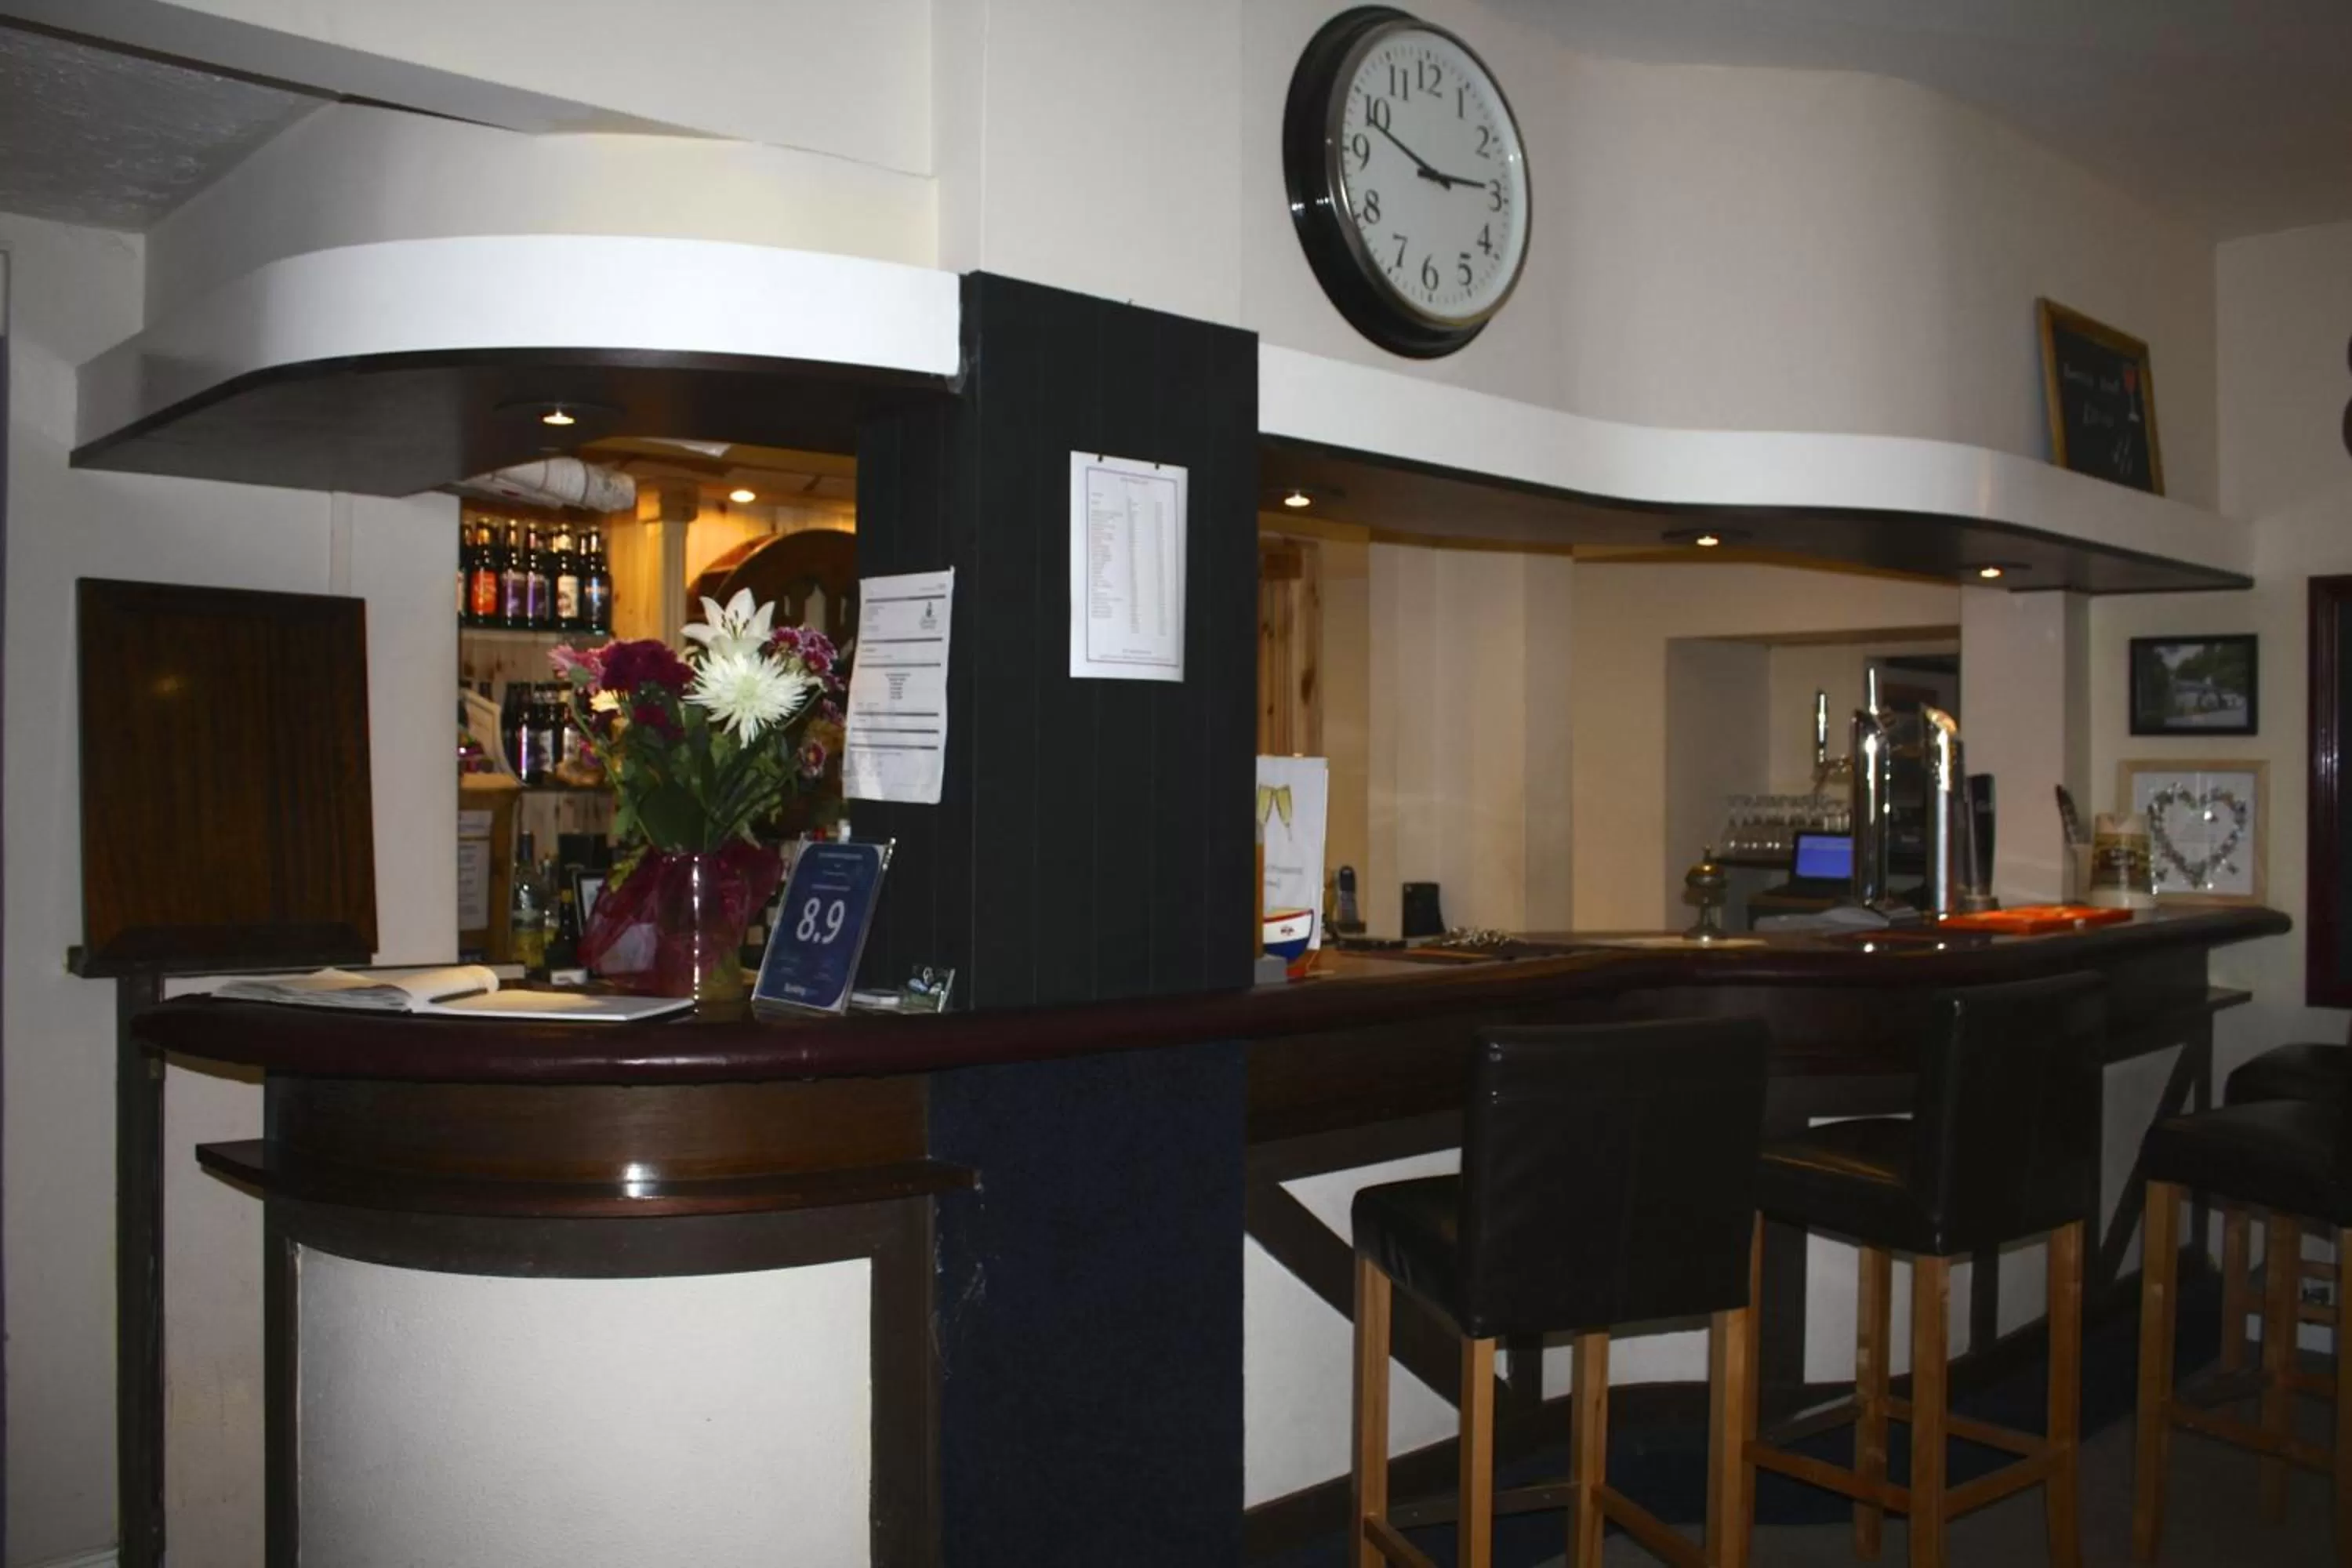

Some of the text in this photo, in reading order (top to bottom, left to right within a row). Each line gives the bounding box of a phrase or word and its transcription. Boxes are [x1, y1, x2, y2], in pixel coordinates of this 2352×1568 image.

[1388, 64, 1409, 101] 11
[1417, 59, 1443, 99] 12
[1365, 94, 1391, 130] 10
[1457, 87, 1465, 119] 1
[1352, 133, 1370, 171] 9
[1475, 125, 1490, 158] 2
[1363, 189, 1381, 225] 8
[1489, 180, 1503, 212] 3
[1393, 233, 1409, 269] 7
[1476, 224, 1493, 256] 4
[1421, 254, 1439, 292] 6
[1457, 252, 1473, 287] 5
[797, 897, 844, 944] 8.9
